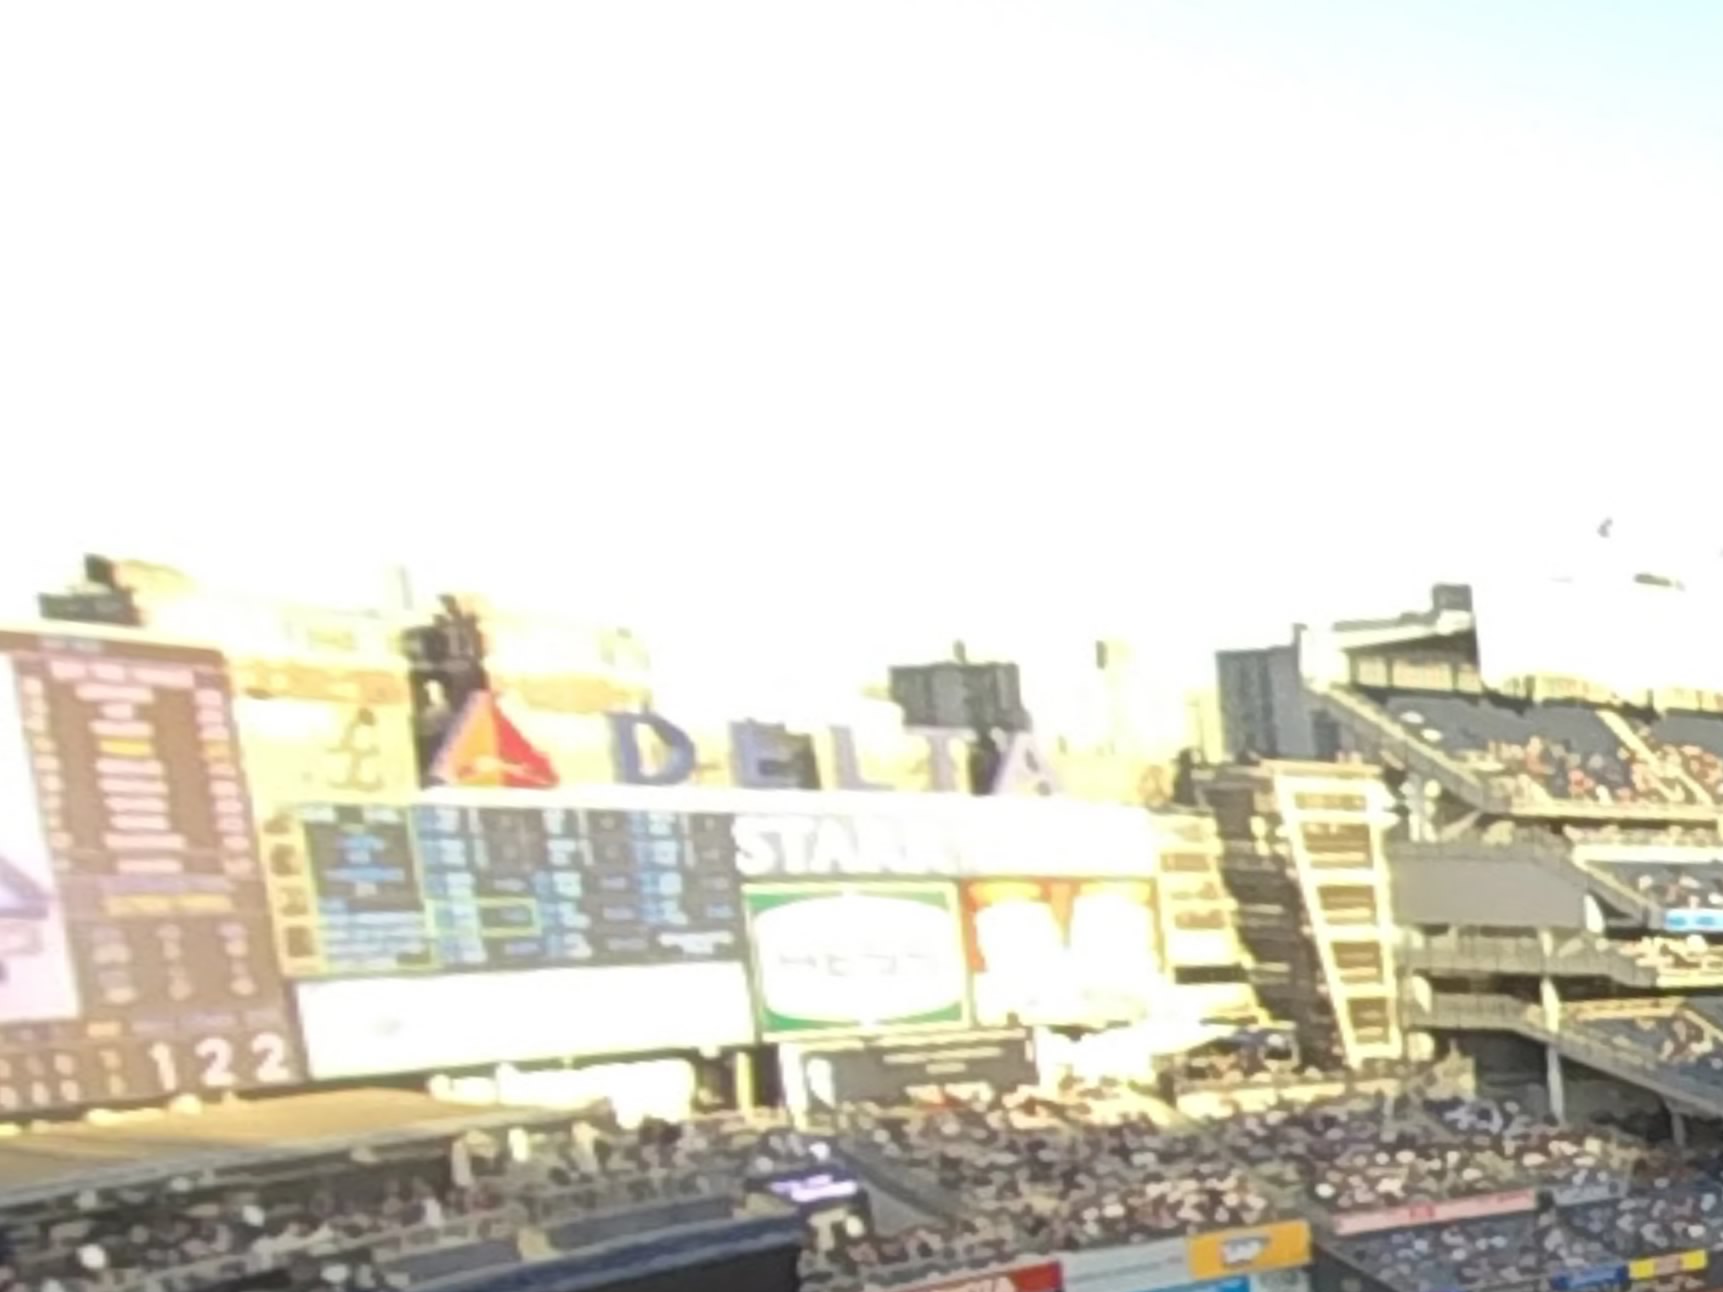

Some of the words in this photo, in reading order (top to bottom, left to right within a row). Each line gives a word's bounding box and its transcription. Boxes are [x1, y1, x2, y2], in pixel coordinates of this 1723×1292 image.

[606, 710, 1057, 797] DELTA
[148, 1042, 179, 1092] 1
[194, 1036, 237, 1087] 2
[250, 1031, 291, 1083] 2
